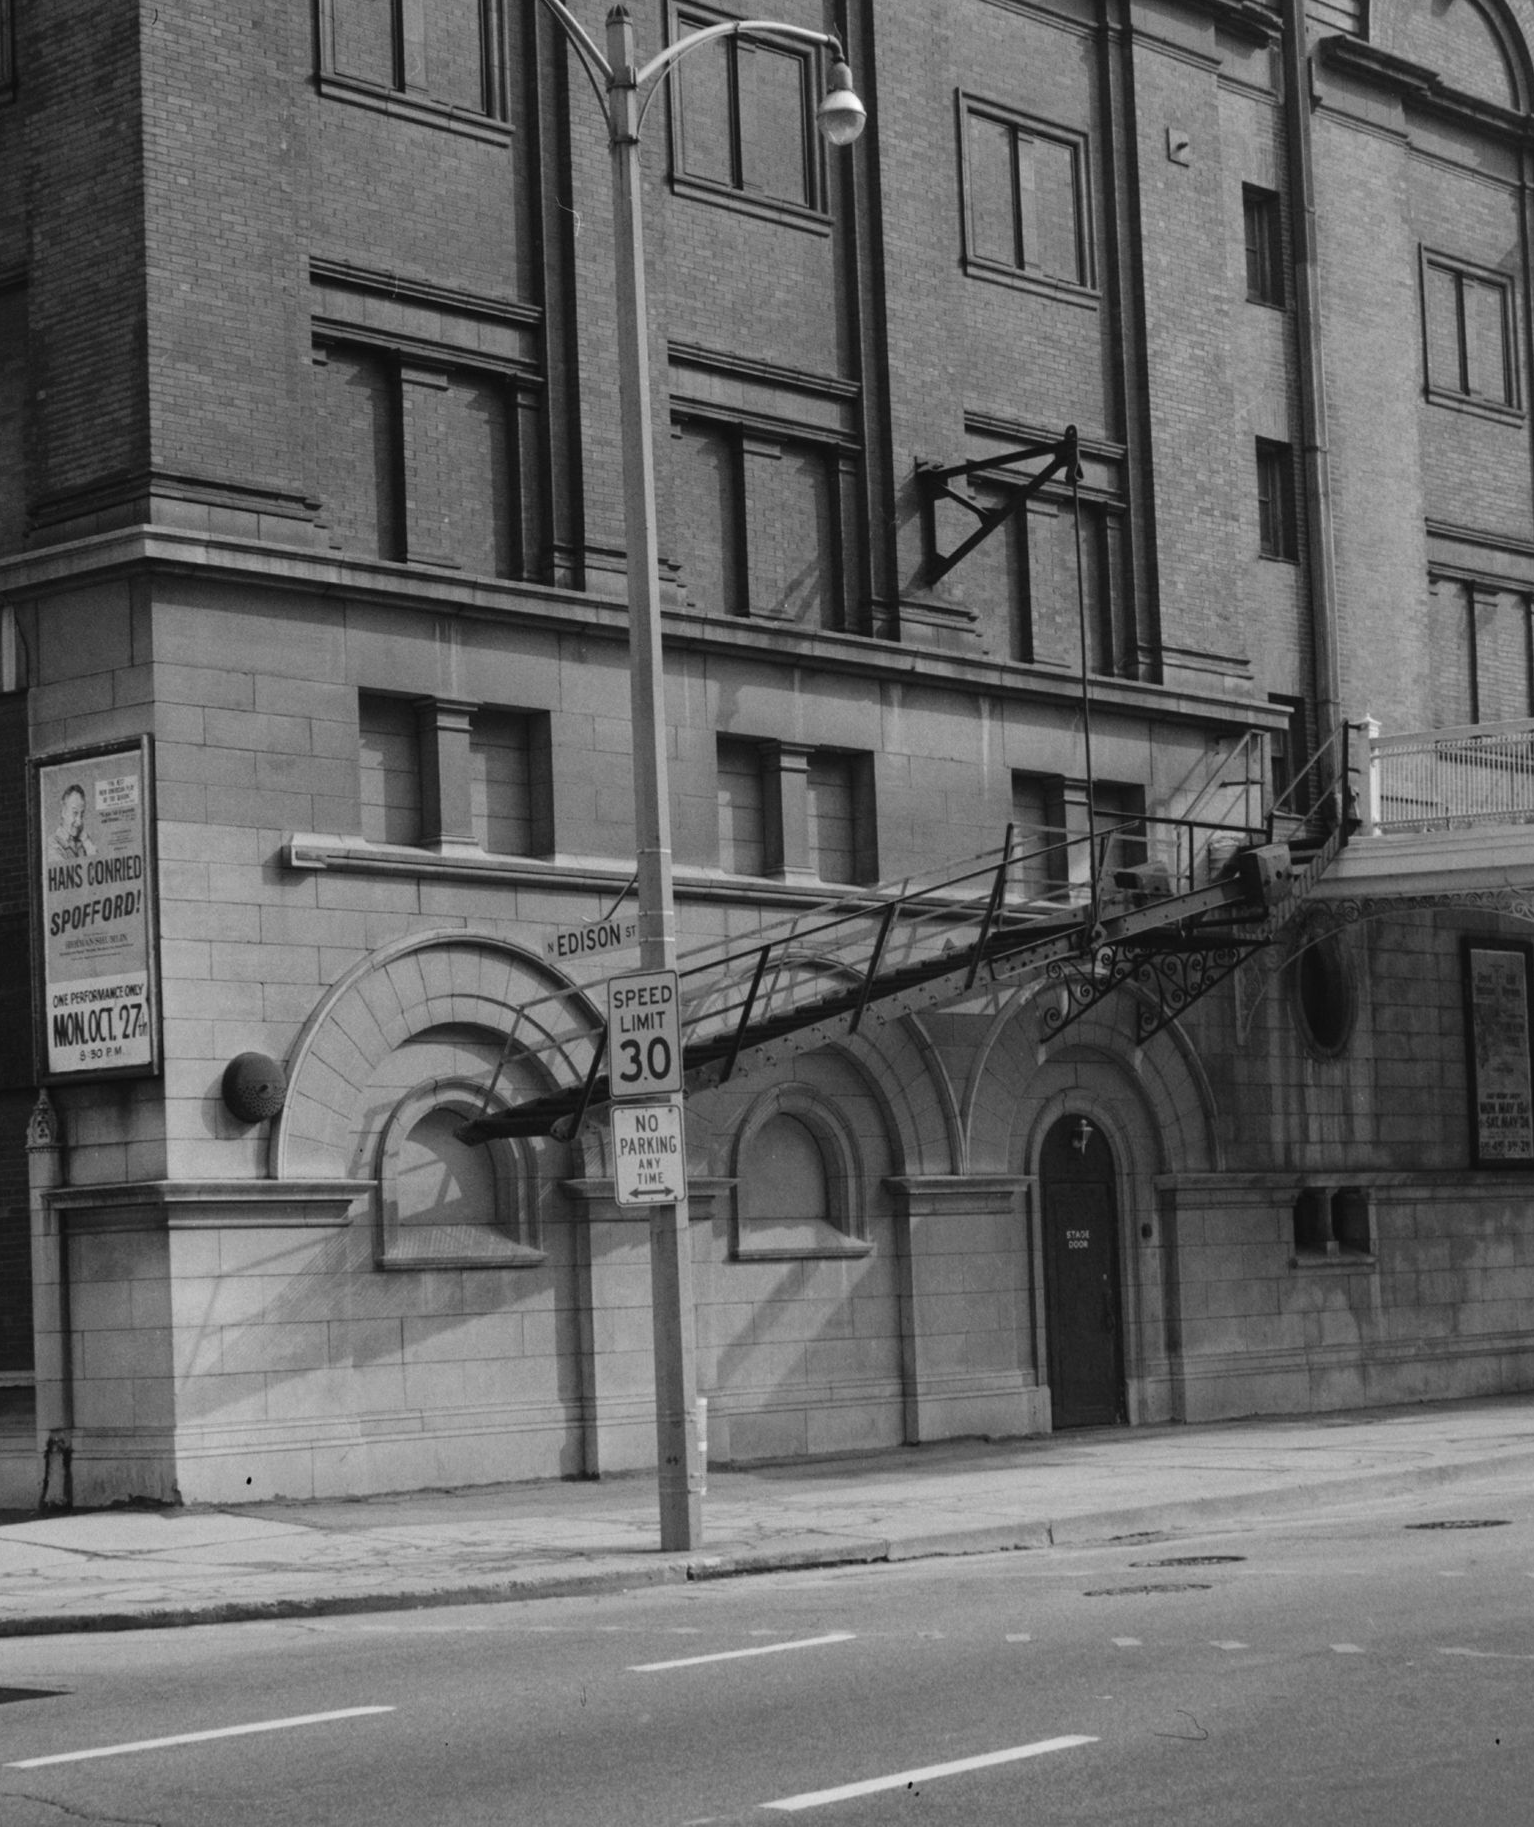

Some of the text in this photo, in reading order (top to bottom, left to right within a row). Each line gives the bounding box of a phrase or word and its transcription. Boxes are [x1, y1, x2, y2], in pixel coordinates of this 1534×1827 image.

[48, 854, 142, 892] HANS CONRIED
[50, 889, 142, 937] SPOFFORD!
[547, 922, 636, 957] N EDISON ST
[52, 983, 145, 1009] ONE PERFORMANCE ONLY
[613, 985, 673, 1009] SPEED
[620, 1010, 666, 1033] LIMIT
[619, 1036, 671, 1083] 30
[635, 1114, 659, 1132] NO
[620, 1135, 677, 1156] PARKING
[638, 1157, 661, 1170] ANY
[637, 1172, 665, 1185] TIME
[1066, 1230, 1090, 1240] STAGE
[1068, 1240, 1089, 1250] DOOR
